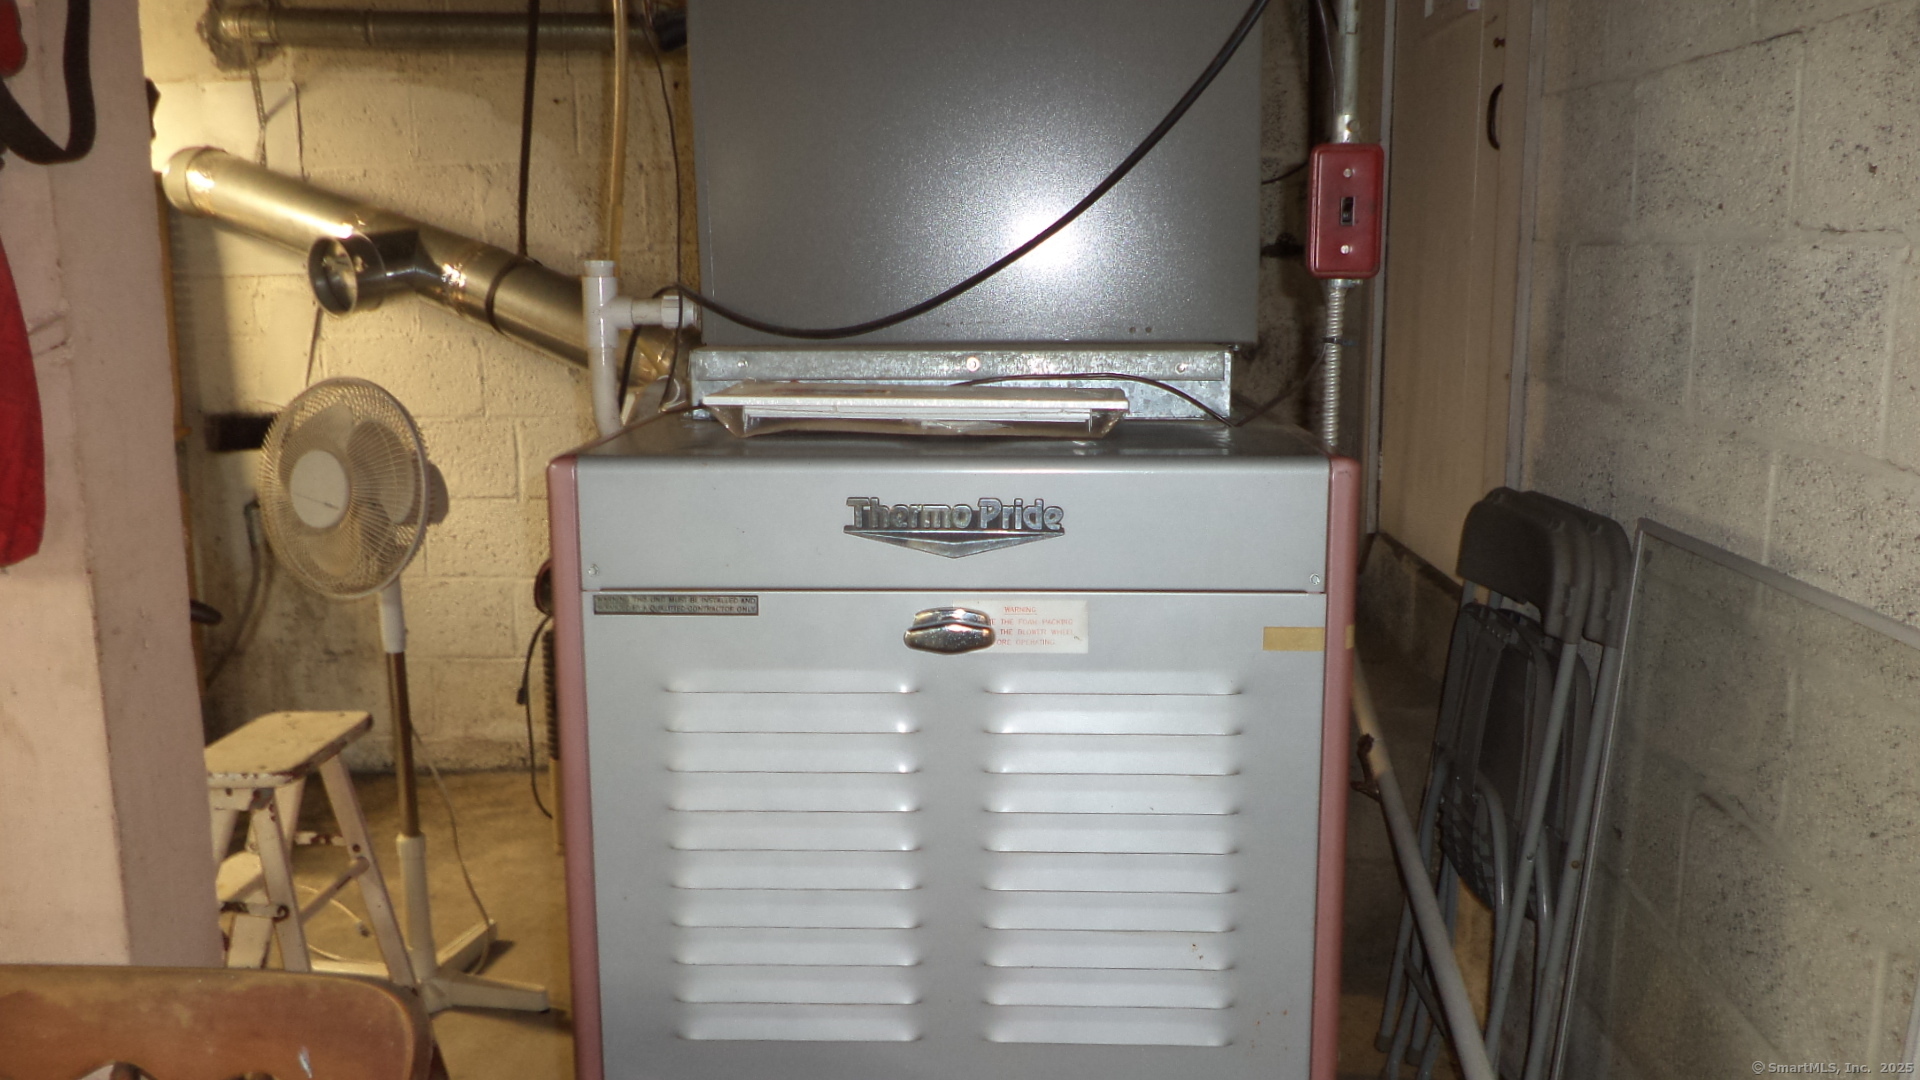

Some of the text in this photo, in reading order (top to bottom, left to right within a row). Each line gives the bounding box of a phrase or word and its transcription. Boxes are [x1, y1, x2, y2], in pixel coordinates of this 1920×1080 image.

[846, 497, 1064, 530] Thermo Pride
[737, 605, 756, 613] ONLY
[1001, 618, 1014, 626] THE
[1042, 618, 1073, 626] PACKING
[1000, 628, 1013, 636] THE
[1018, 628, 1046, 636] BLOWER
